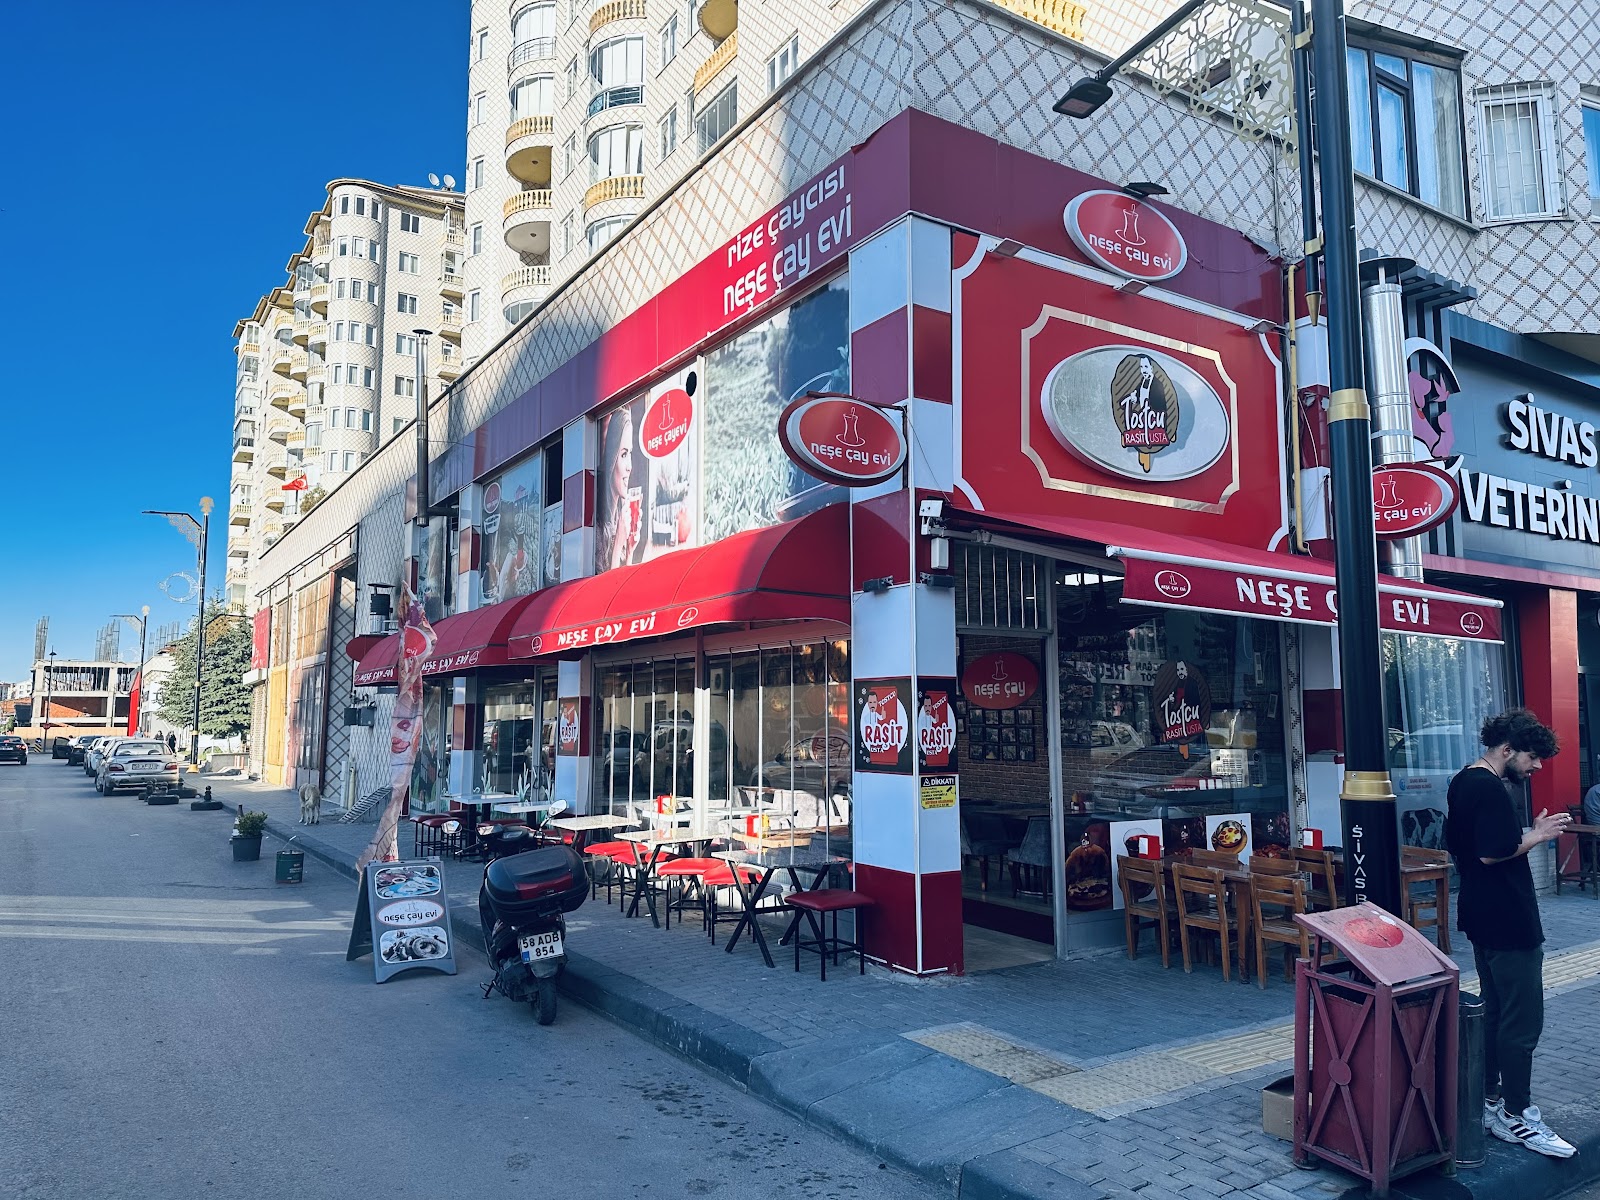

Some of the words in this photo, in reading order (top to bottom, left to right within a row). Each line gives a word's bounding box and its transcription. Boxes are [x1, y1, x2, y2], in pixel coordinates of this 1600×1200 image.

[727, 223, 764, 268] rize
[767, 164, 845, 246] çaycısı
[723, 261, 767, 316] neşe
[772, 232, 811, 294] çay
[817, 193, 852, 254] evi
[1089, 233, 1122, 255] neşe
[1125, 246, 1150, 267] çay
[1152, 253, 1172, 271] evi
[1121, 394, 1165, 445] Tostcu
[1508, 392, 1598, 468] SİVAS
[647, 434, 663, 451] neşe
[1149, 432, 1168, 443] USTA
[810, 442, 843, 460] neşe
[845, 448, 869, 466] çay
[872, 449, 891, 466] evi
[1383, 508, 1408, 522] çay
[1411, 502, 1432, 516] evi
[1460, 467, 1600, 544] VETERİN
[1235, 576, 1312, 617] NEŞE
[1392, 597, 1430, 626] EVİ
[557, 628, 588, 648] NEŞE
[592, 622, 623, 646] ÇAY
[629, 611, 657, 635] EVİ
[974, 682, 1000, 699] neşe
[1004, 681, 1026, 698] çay
[1161, 697, 1200, 737] Tostcu
[1186, 723, 1203, 735] USTA
[864, 720, 903, 749] RAŞİT
[921, 724, 953, 751] RAŞİT
[384, 913, 405, 922] neşe
[407, 912, 423, 921] çay
[425, 909, 437, 918] evi
[522, 937, 535, 949] 58
[538, 931, 560, 946] ADB
[535, 945, 555, 957] 854
